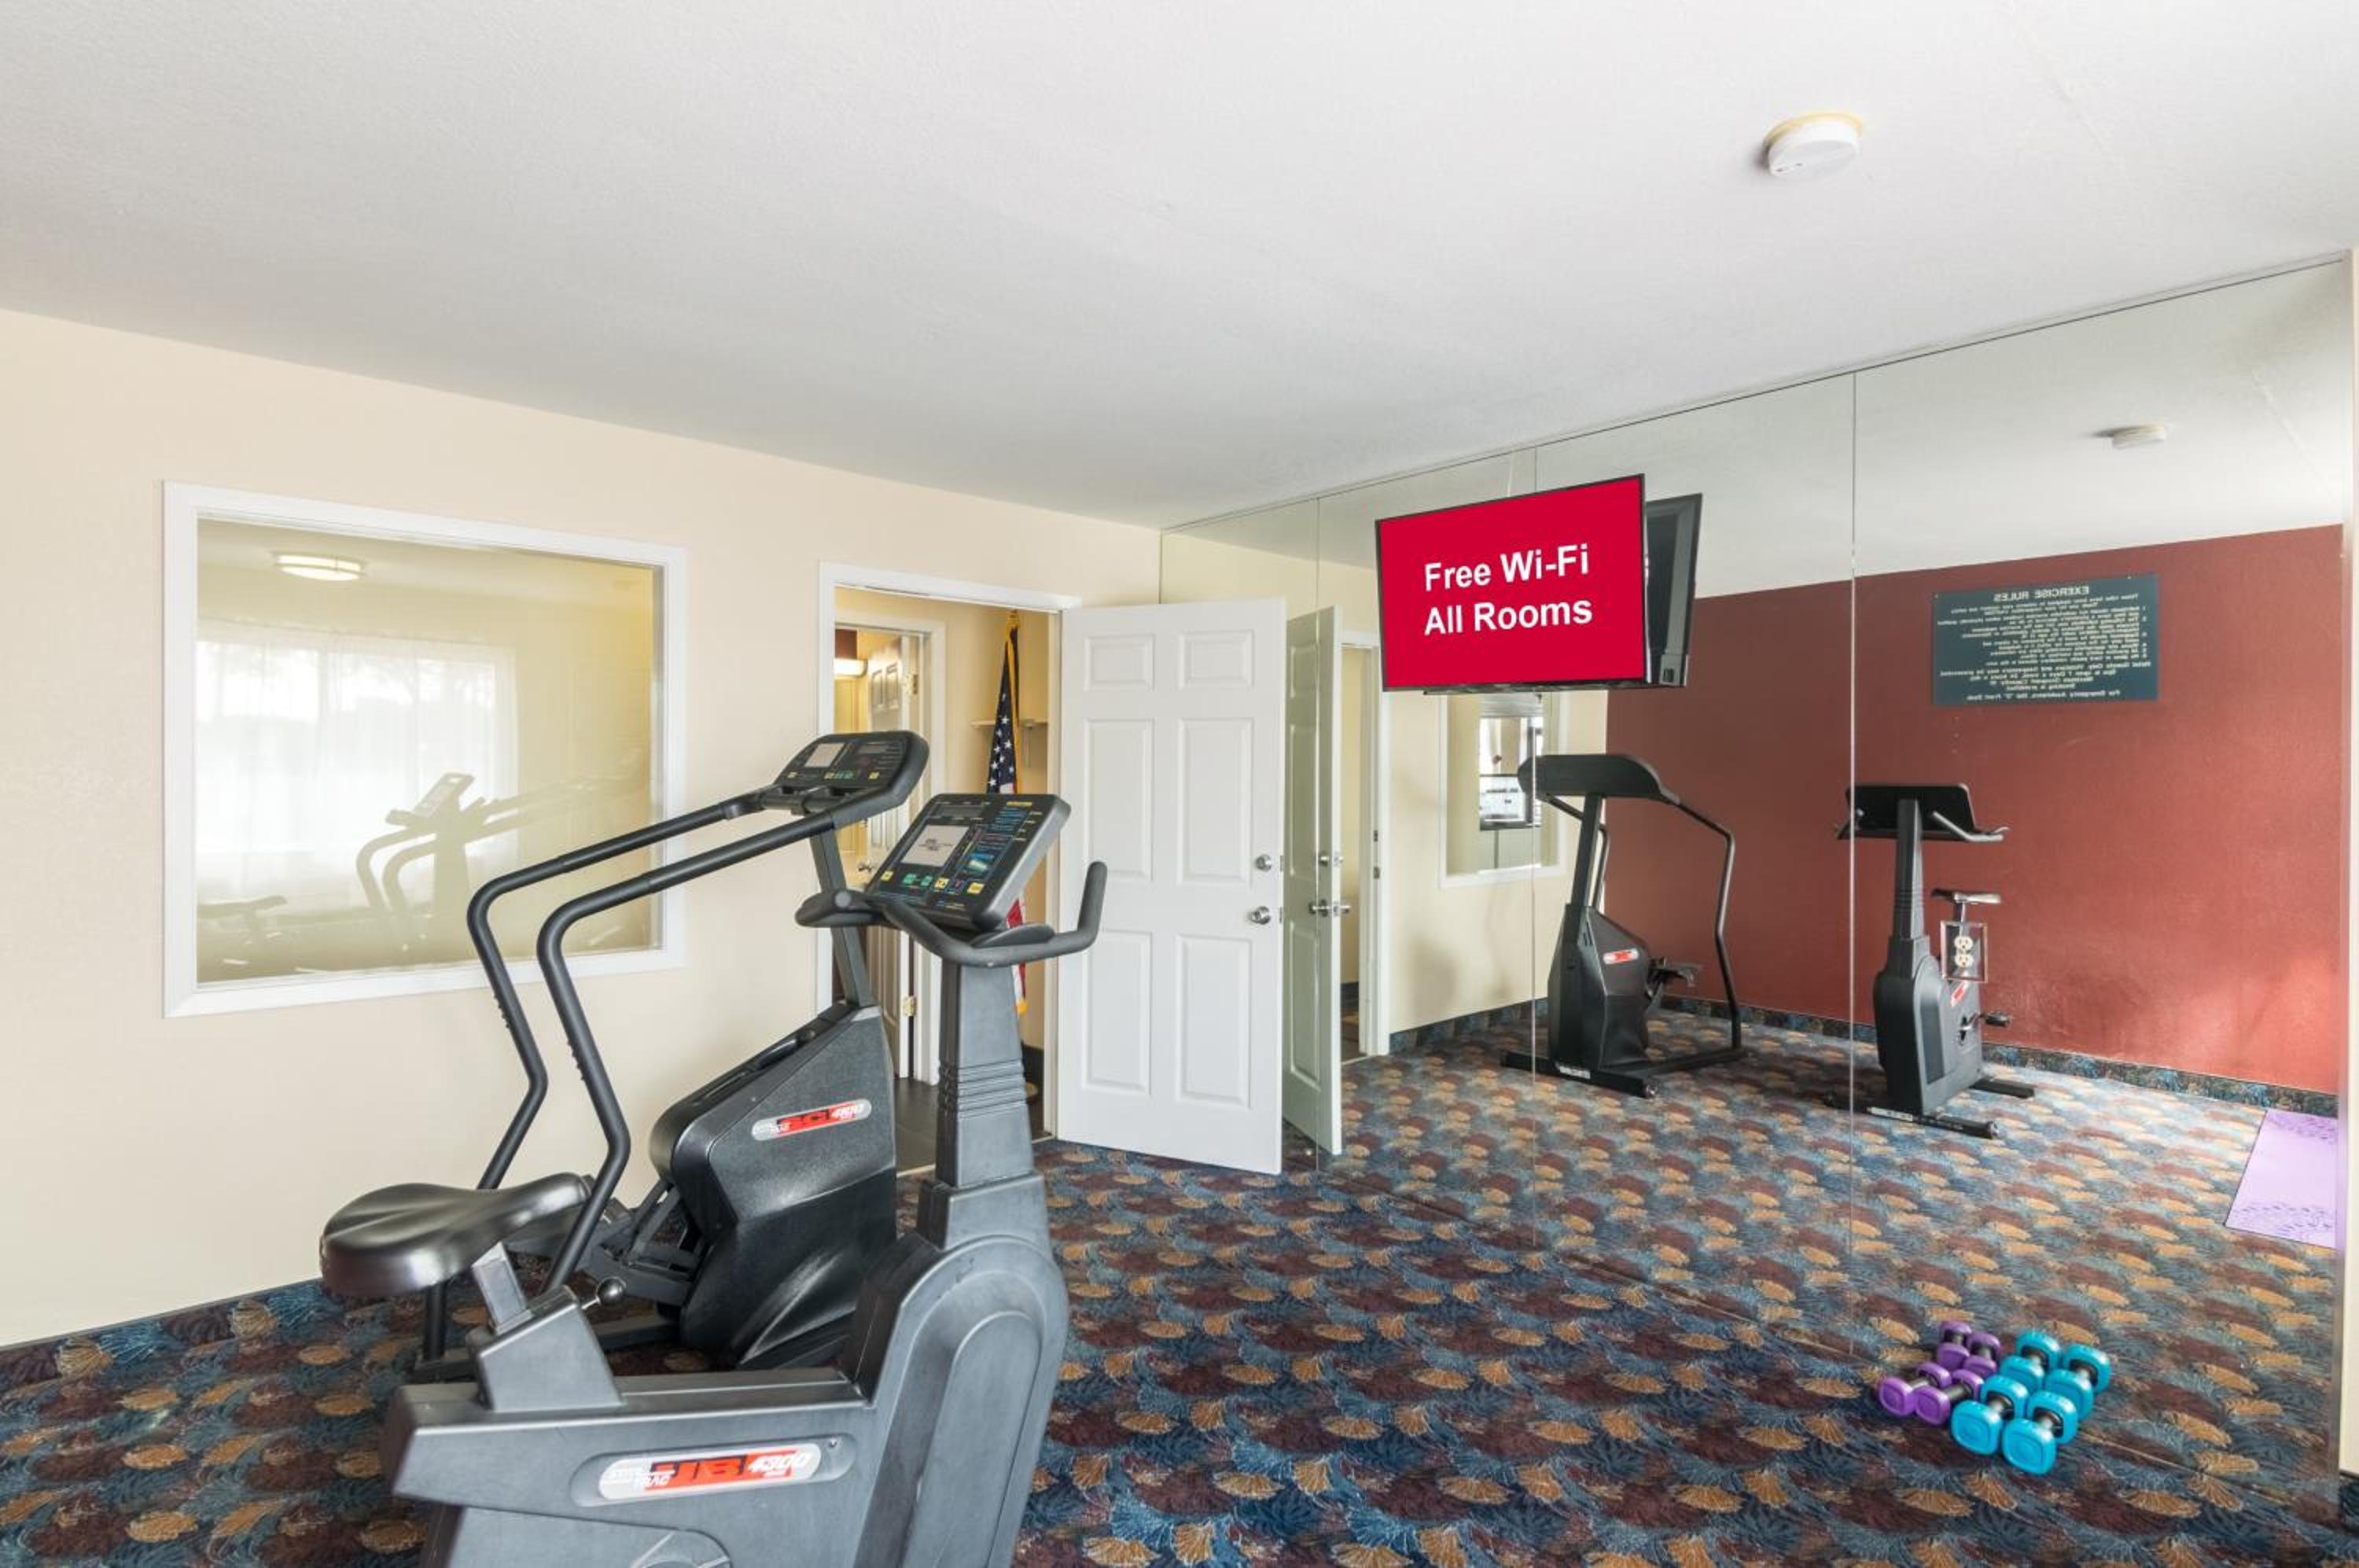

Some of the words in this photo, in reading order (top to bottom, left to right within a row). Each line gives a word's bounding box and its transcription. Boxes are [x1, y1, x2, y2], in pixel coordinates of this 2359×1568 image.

[1424, 562, 1492, 591] Free
[1500, 543, 1590, 583] Wi-Fi
[1424, 605, 1463, 636] All
[1474, 598, 1593, 632] Rooms
